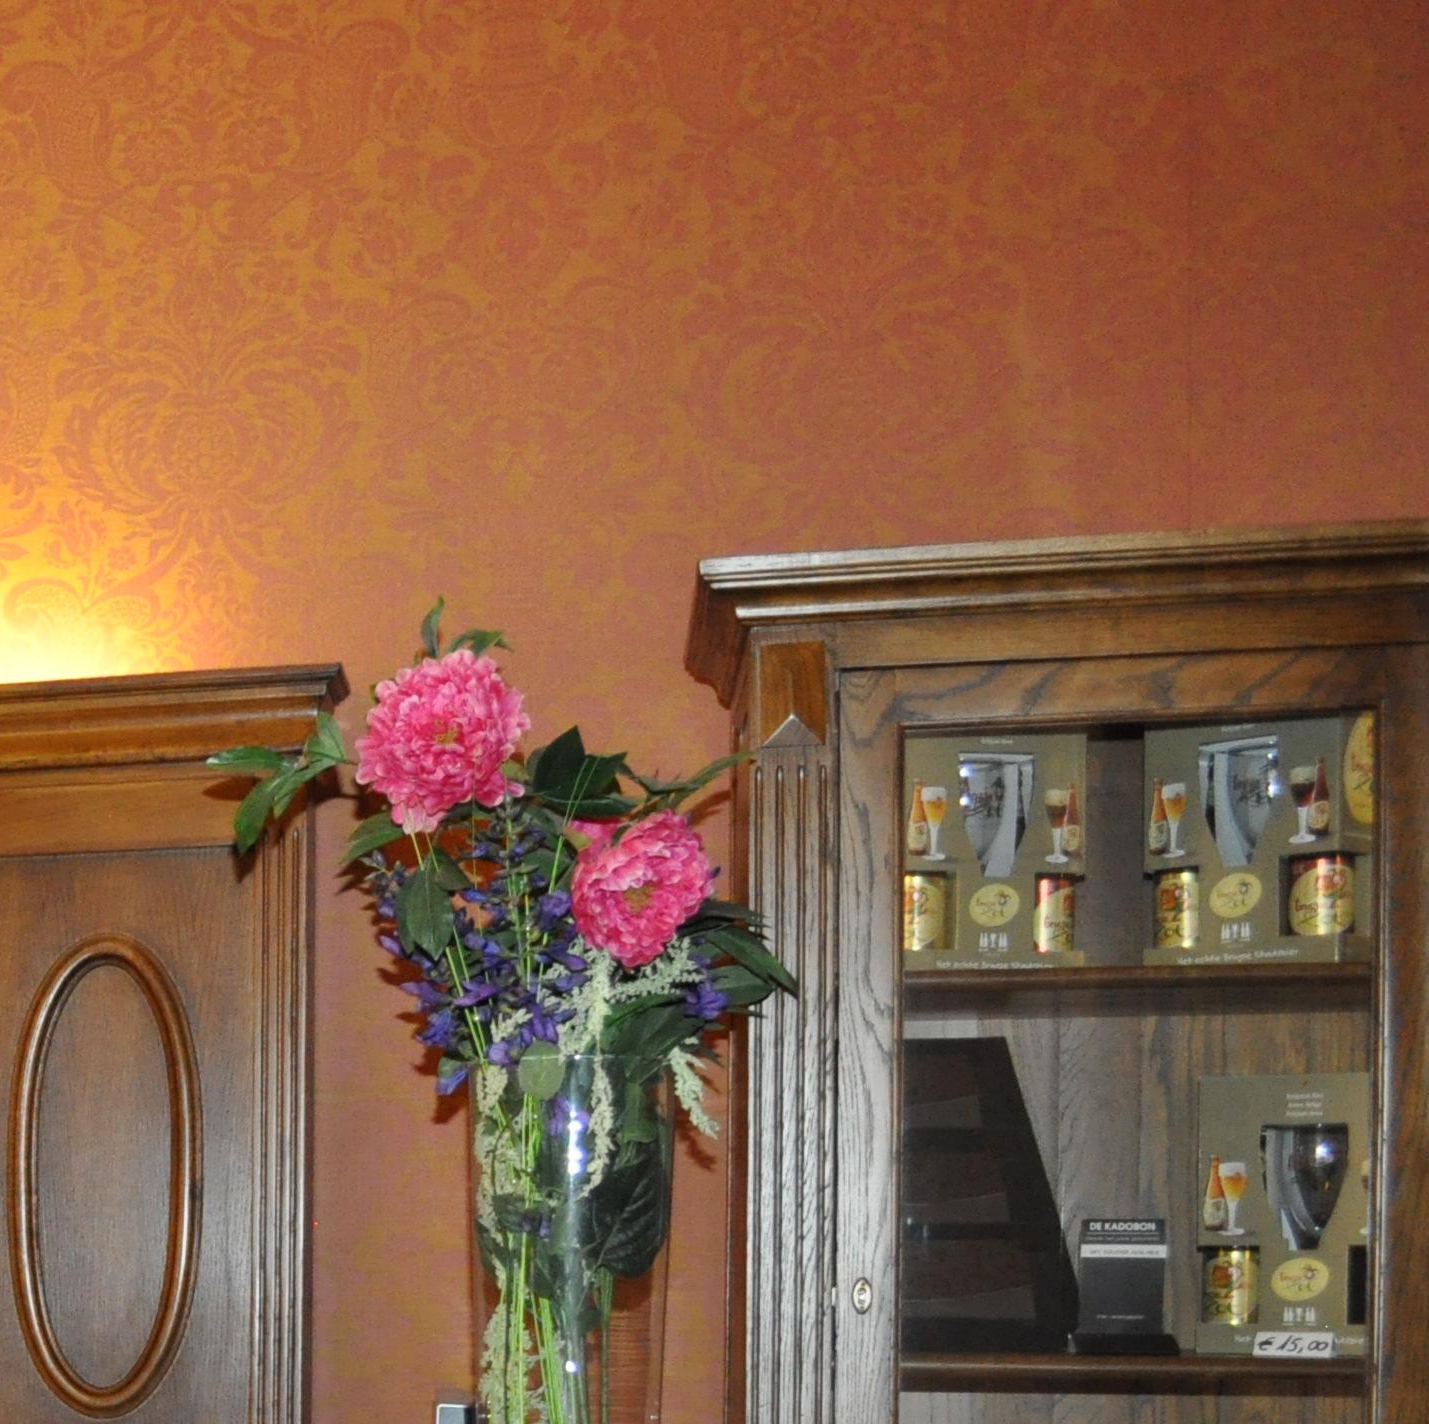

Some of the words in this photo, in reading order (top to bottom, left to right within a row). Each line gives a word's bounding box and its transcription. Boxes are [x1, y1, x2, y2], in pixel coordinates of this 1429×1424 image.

[1089, 1222, 1102, 1231] DE
[1104, 1222, 1156, 1231] KADOBON
[1257, 1336, 1275, 1351] €
[1276, 1335, 1329, 1354] 15,00
